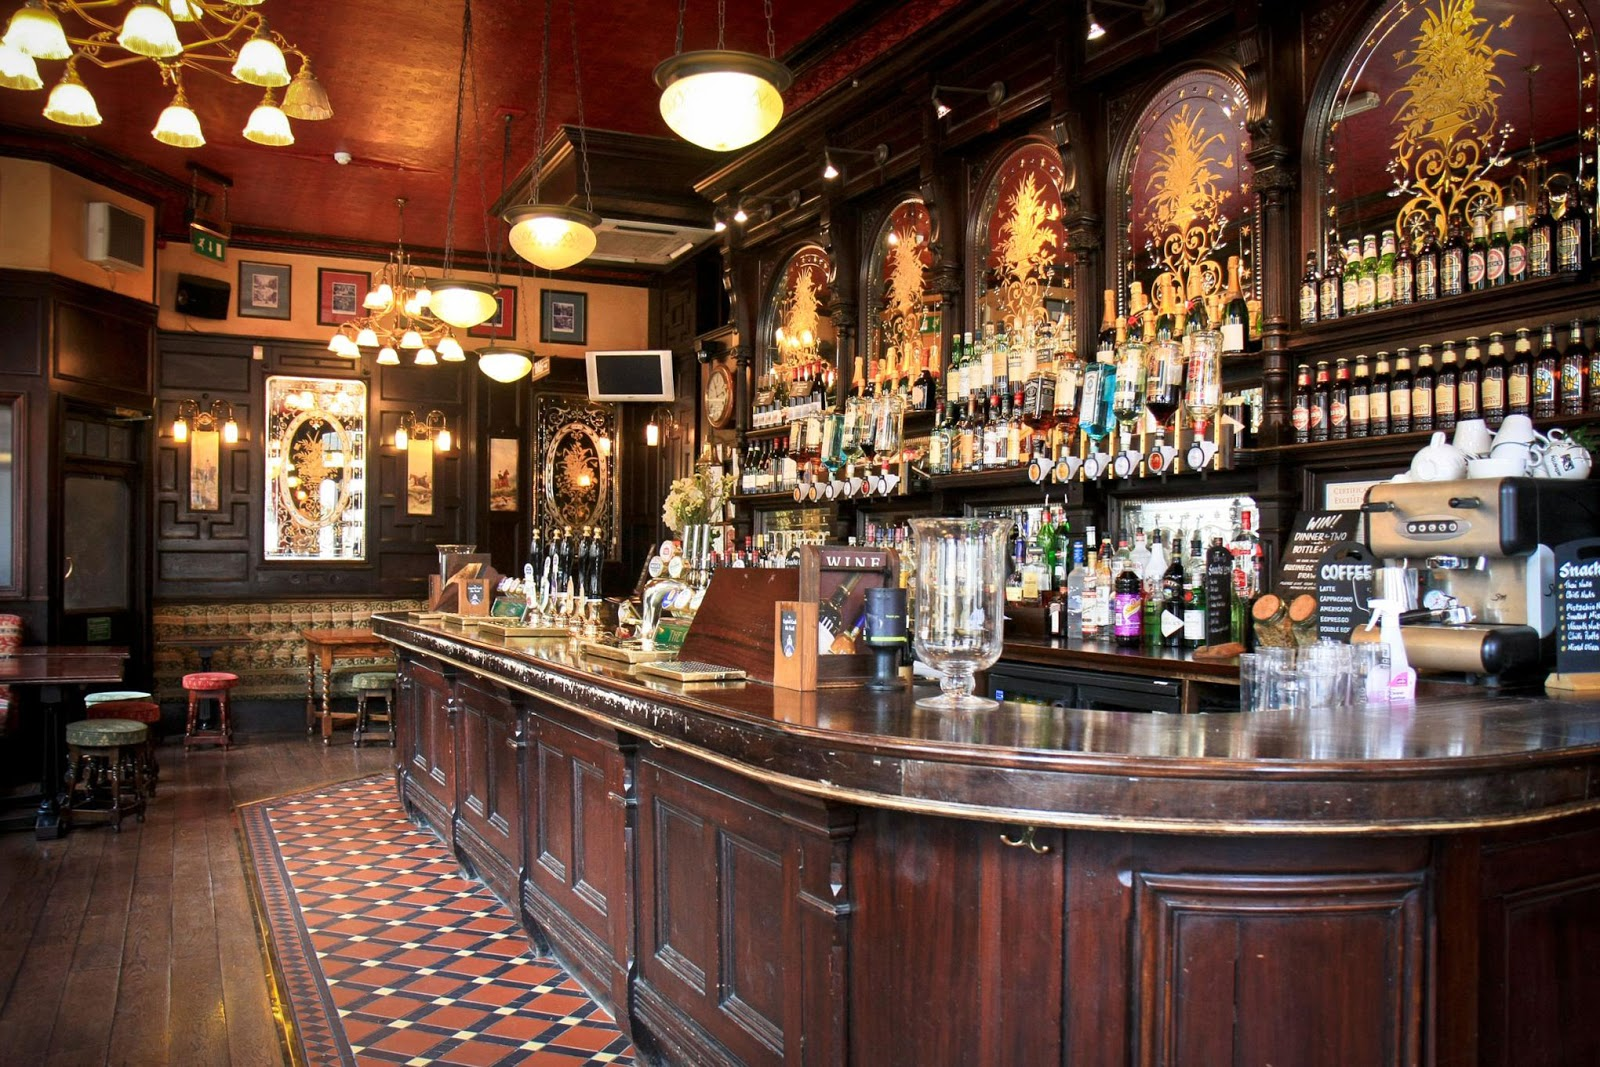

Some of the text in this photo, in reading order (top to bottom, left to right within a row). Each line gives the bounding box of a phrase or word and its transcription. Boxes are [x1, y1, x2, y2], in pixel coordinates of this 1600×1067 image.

[1306, 514, 1342, 530] WIN!
[1294, 532, 1324, 541] DINNER
[1330, 532, 1347, 541] TWO
[1292, 545, 1319, 554] BOTTLE
[826, 556, 880, 567] WINE
[1321, 564, 1372, 581] COFFEE
